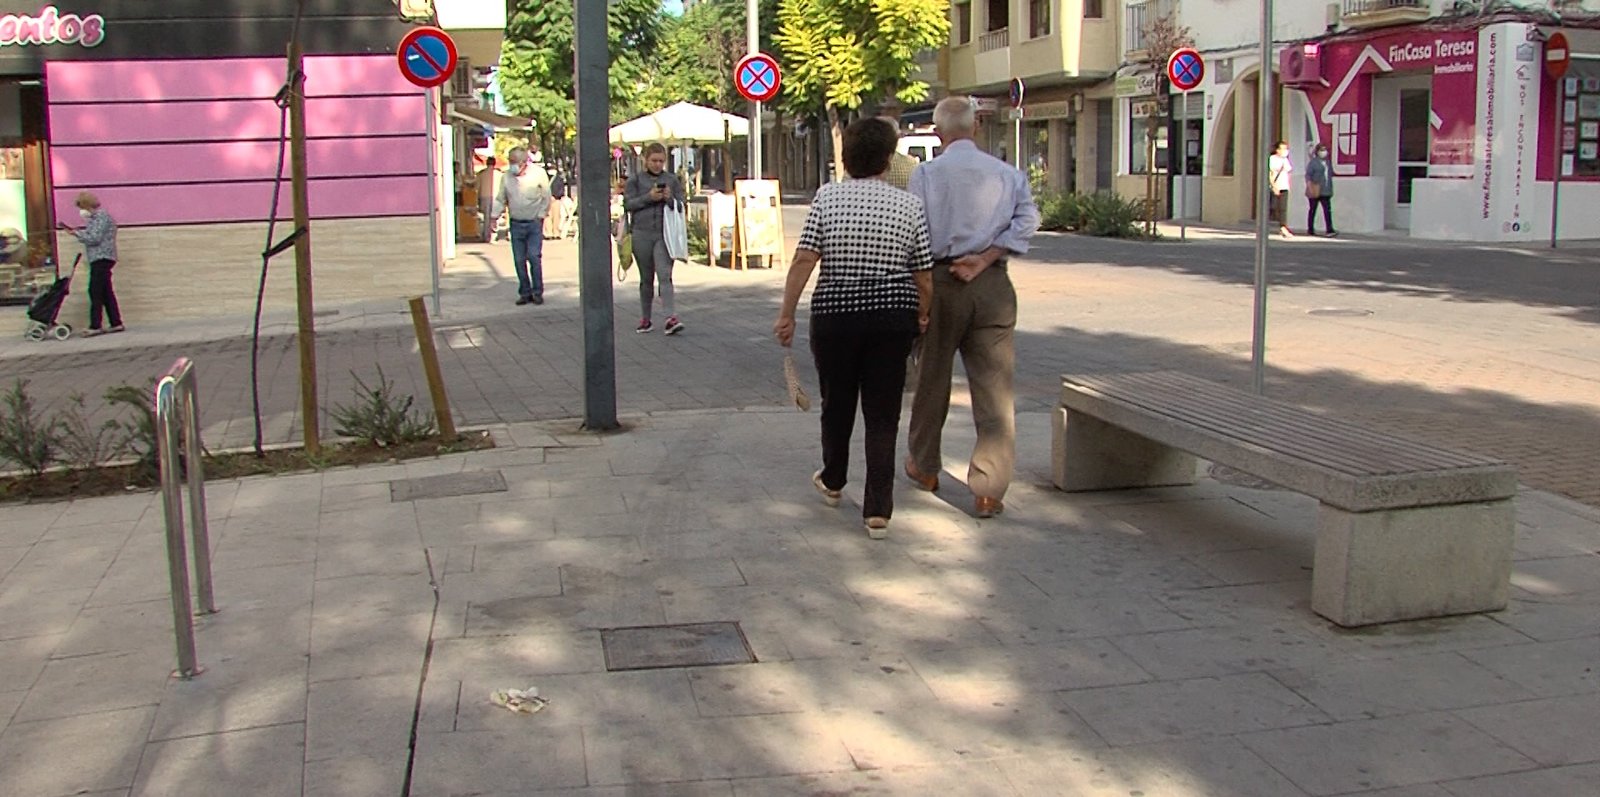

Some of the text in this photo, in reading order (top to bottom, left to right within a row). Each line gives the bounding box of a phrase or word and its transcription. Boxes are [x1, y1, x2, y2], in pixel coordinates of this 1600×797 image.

[1389, 39, 1475, 63] FinCasa Teresa
[1434, 62, 1474, 74] Inmobiliaria
[1482, 33, 1496, 219] www.fincasateresainmobiliaria.com
